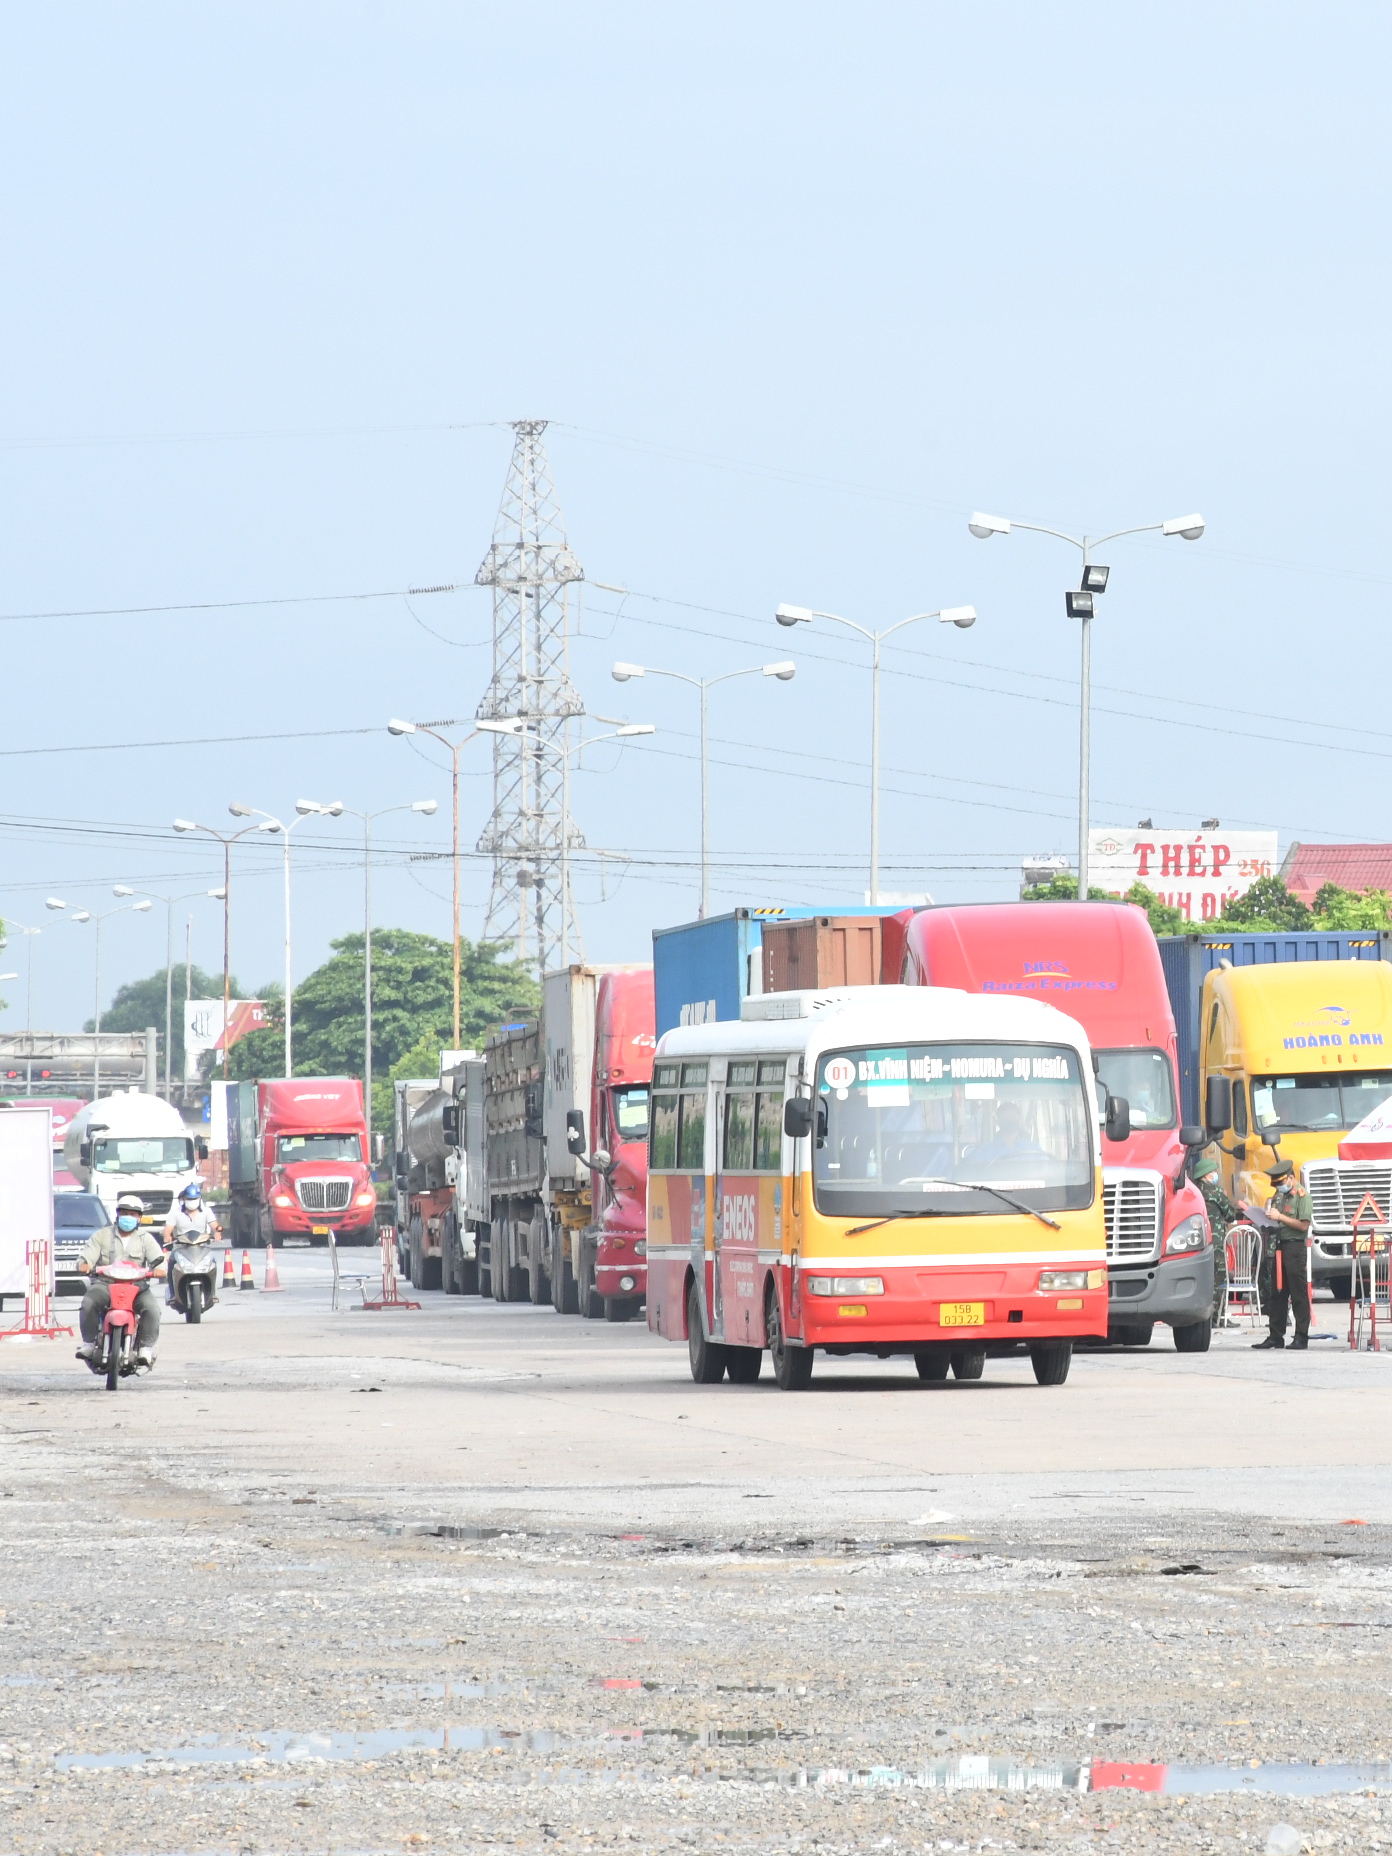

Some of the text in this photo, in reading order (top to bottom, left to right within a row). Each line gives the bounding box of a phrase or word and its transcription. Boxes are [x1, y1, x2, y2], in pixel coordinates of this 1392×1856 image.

[1133, 836, 1271, 878] THÉP 256
[1024, 961, 1069, 973] NRS
[1041, 979, 1116, 991] Express
[1283, 1033, 1384, 1049] HOÀNG ANH
[832, 1066, 849, 1080] 01
[1033, 1056, 1069, 1079] NGHĨA
[723, 1194, 755, 1241] ENEOS
[954, 1304, 971, 1314] 15B
[944, 1314, 979, 1325] 033.22
